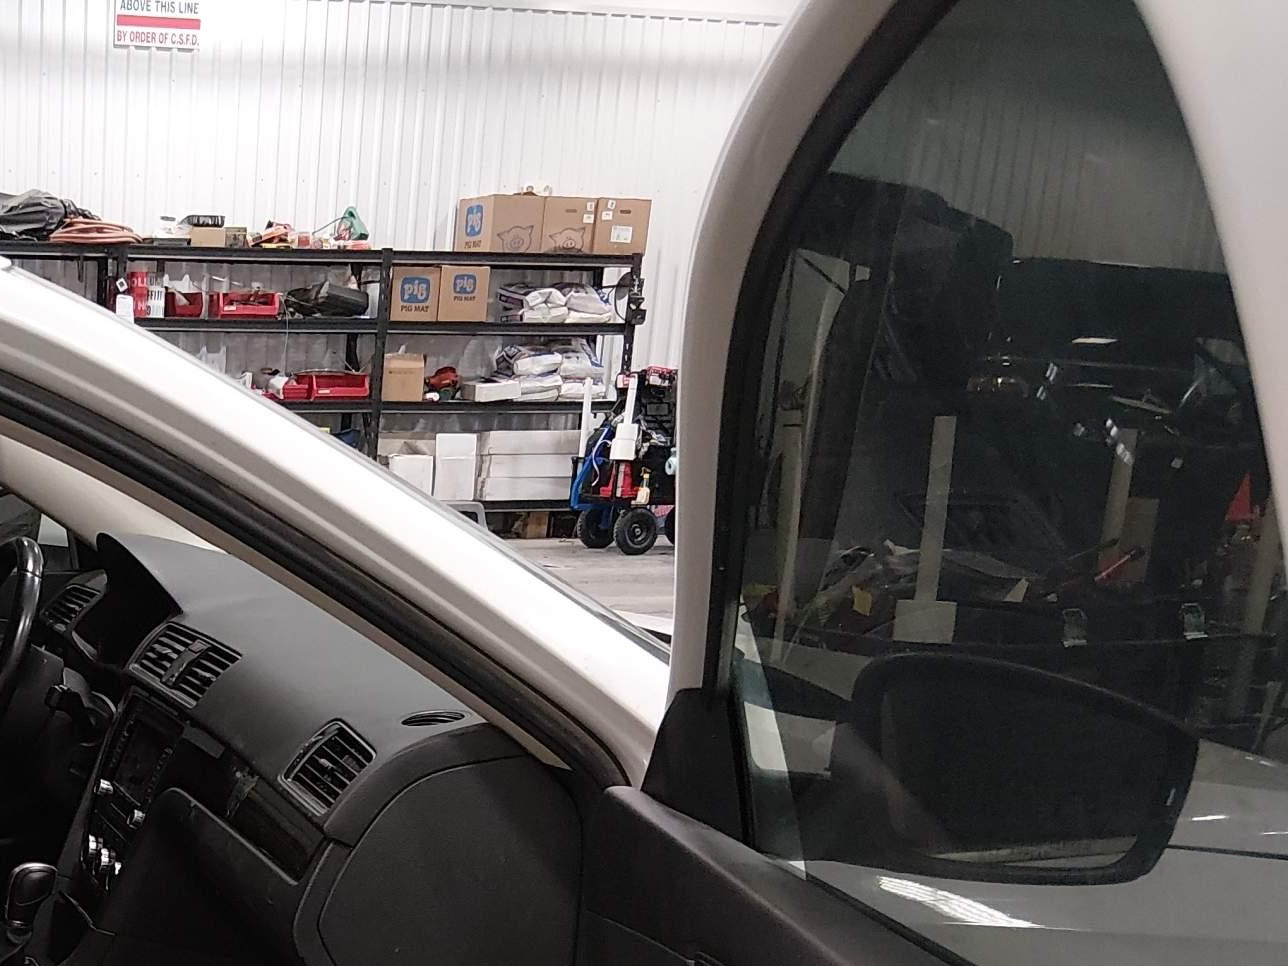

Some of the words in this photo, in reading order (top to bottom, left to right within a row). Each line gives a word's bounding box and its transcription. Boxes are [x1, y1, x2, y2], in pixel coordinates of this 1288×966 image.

[120, 0, 151, 12] ABOVE
[155, 1, 176, 13] THIS
[179, 3, 199, 14] LINE
[117, 30, 128, 42] BY
[129, 31, 156, 44] ORDER
[159, 32, 169, 44] OF
[414, 305, 429, 313] MAT
